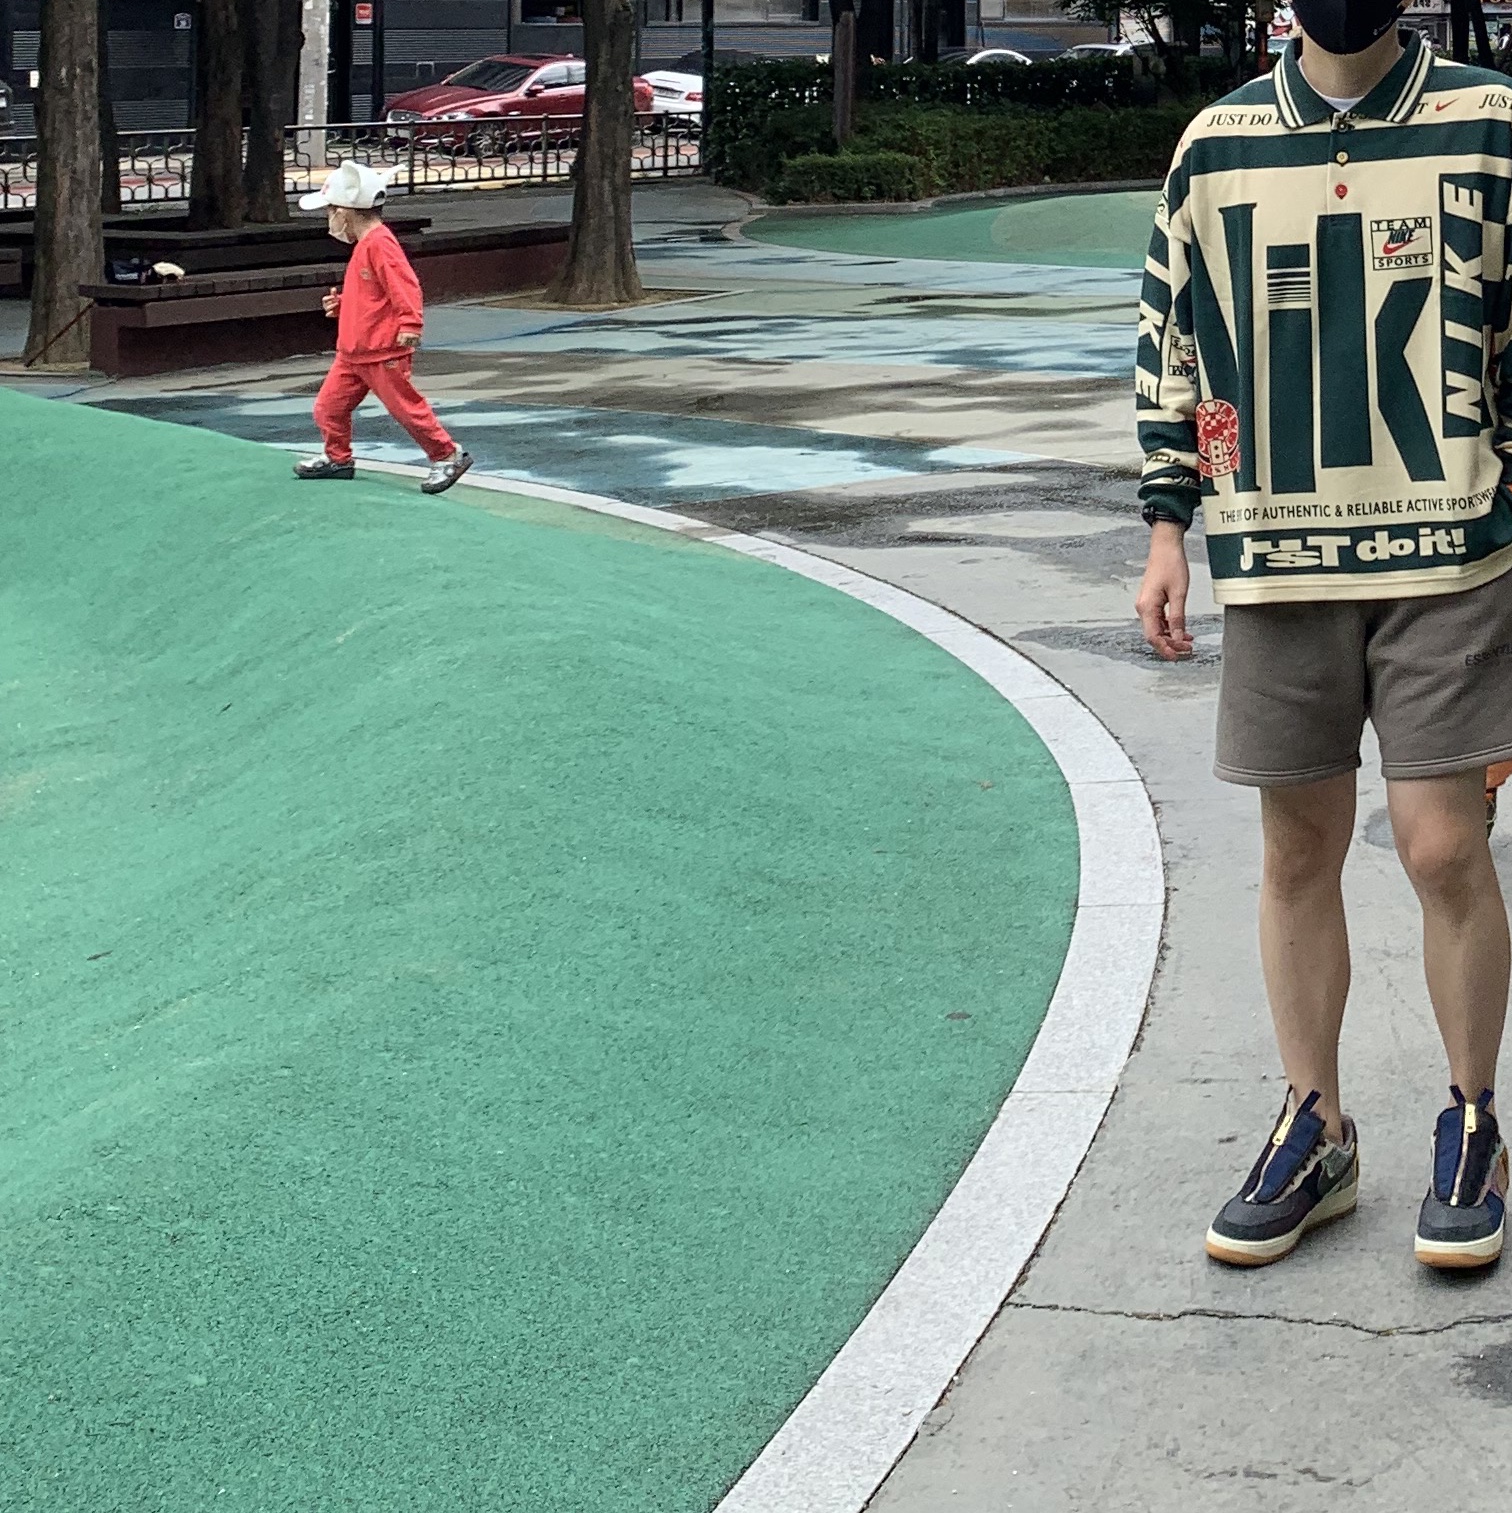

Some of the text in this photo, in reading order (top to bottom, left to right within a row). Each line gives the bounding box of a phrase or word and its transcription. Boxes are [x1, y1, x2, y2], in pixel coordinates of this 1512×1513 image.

[1206, 113, 1248, 127] JUST
[1249, 113, 1273, 126] DO
[1374, 217, 1427, 231] TEAM
[1378, 254, 1429, 268] SPORTS
[1442, 180, 1484, 424] NIKE
[1244, 507, 1259, 521] OF
[1262, 504, 1331, 520] AUTHENTIC
[1334, 504, 1343, 517] &
[1347, 500, 1403, 517] RELIABLE
[1406, 498, 1444, 513] ACTIVE
[1355, 530, 1416, 562] do
